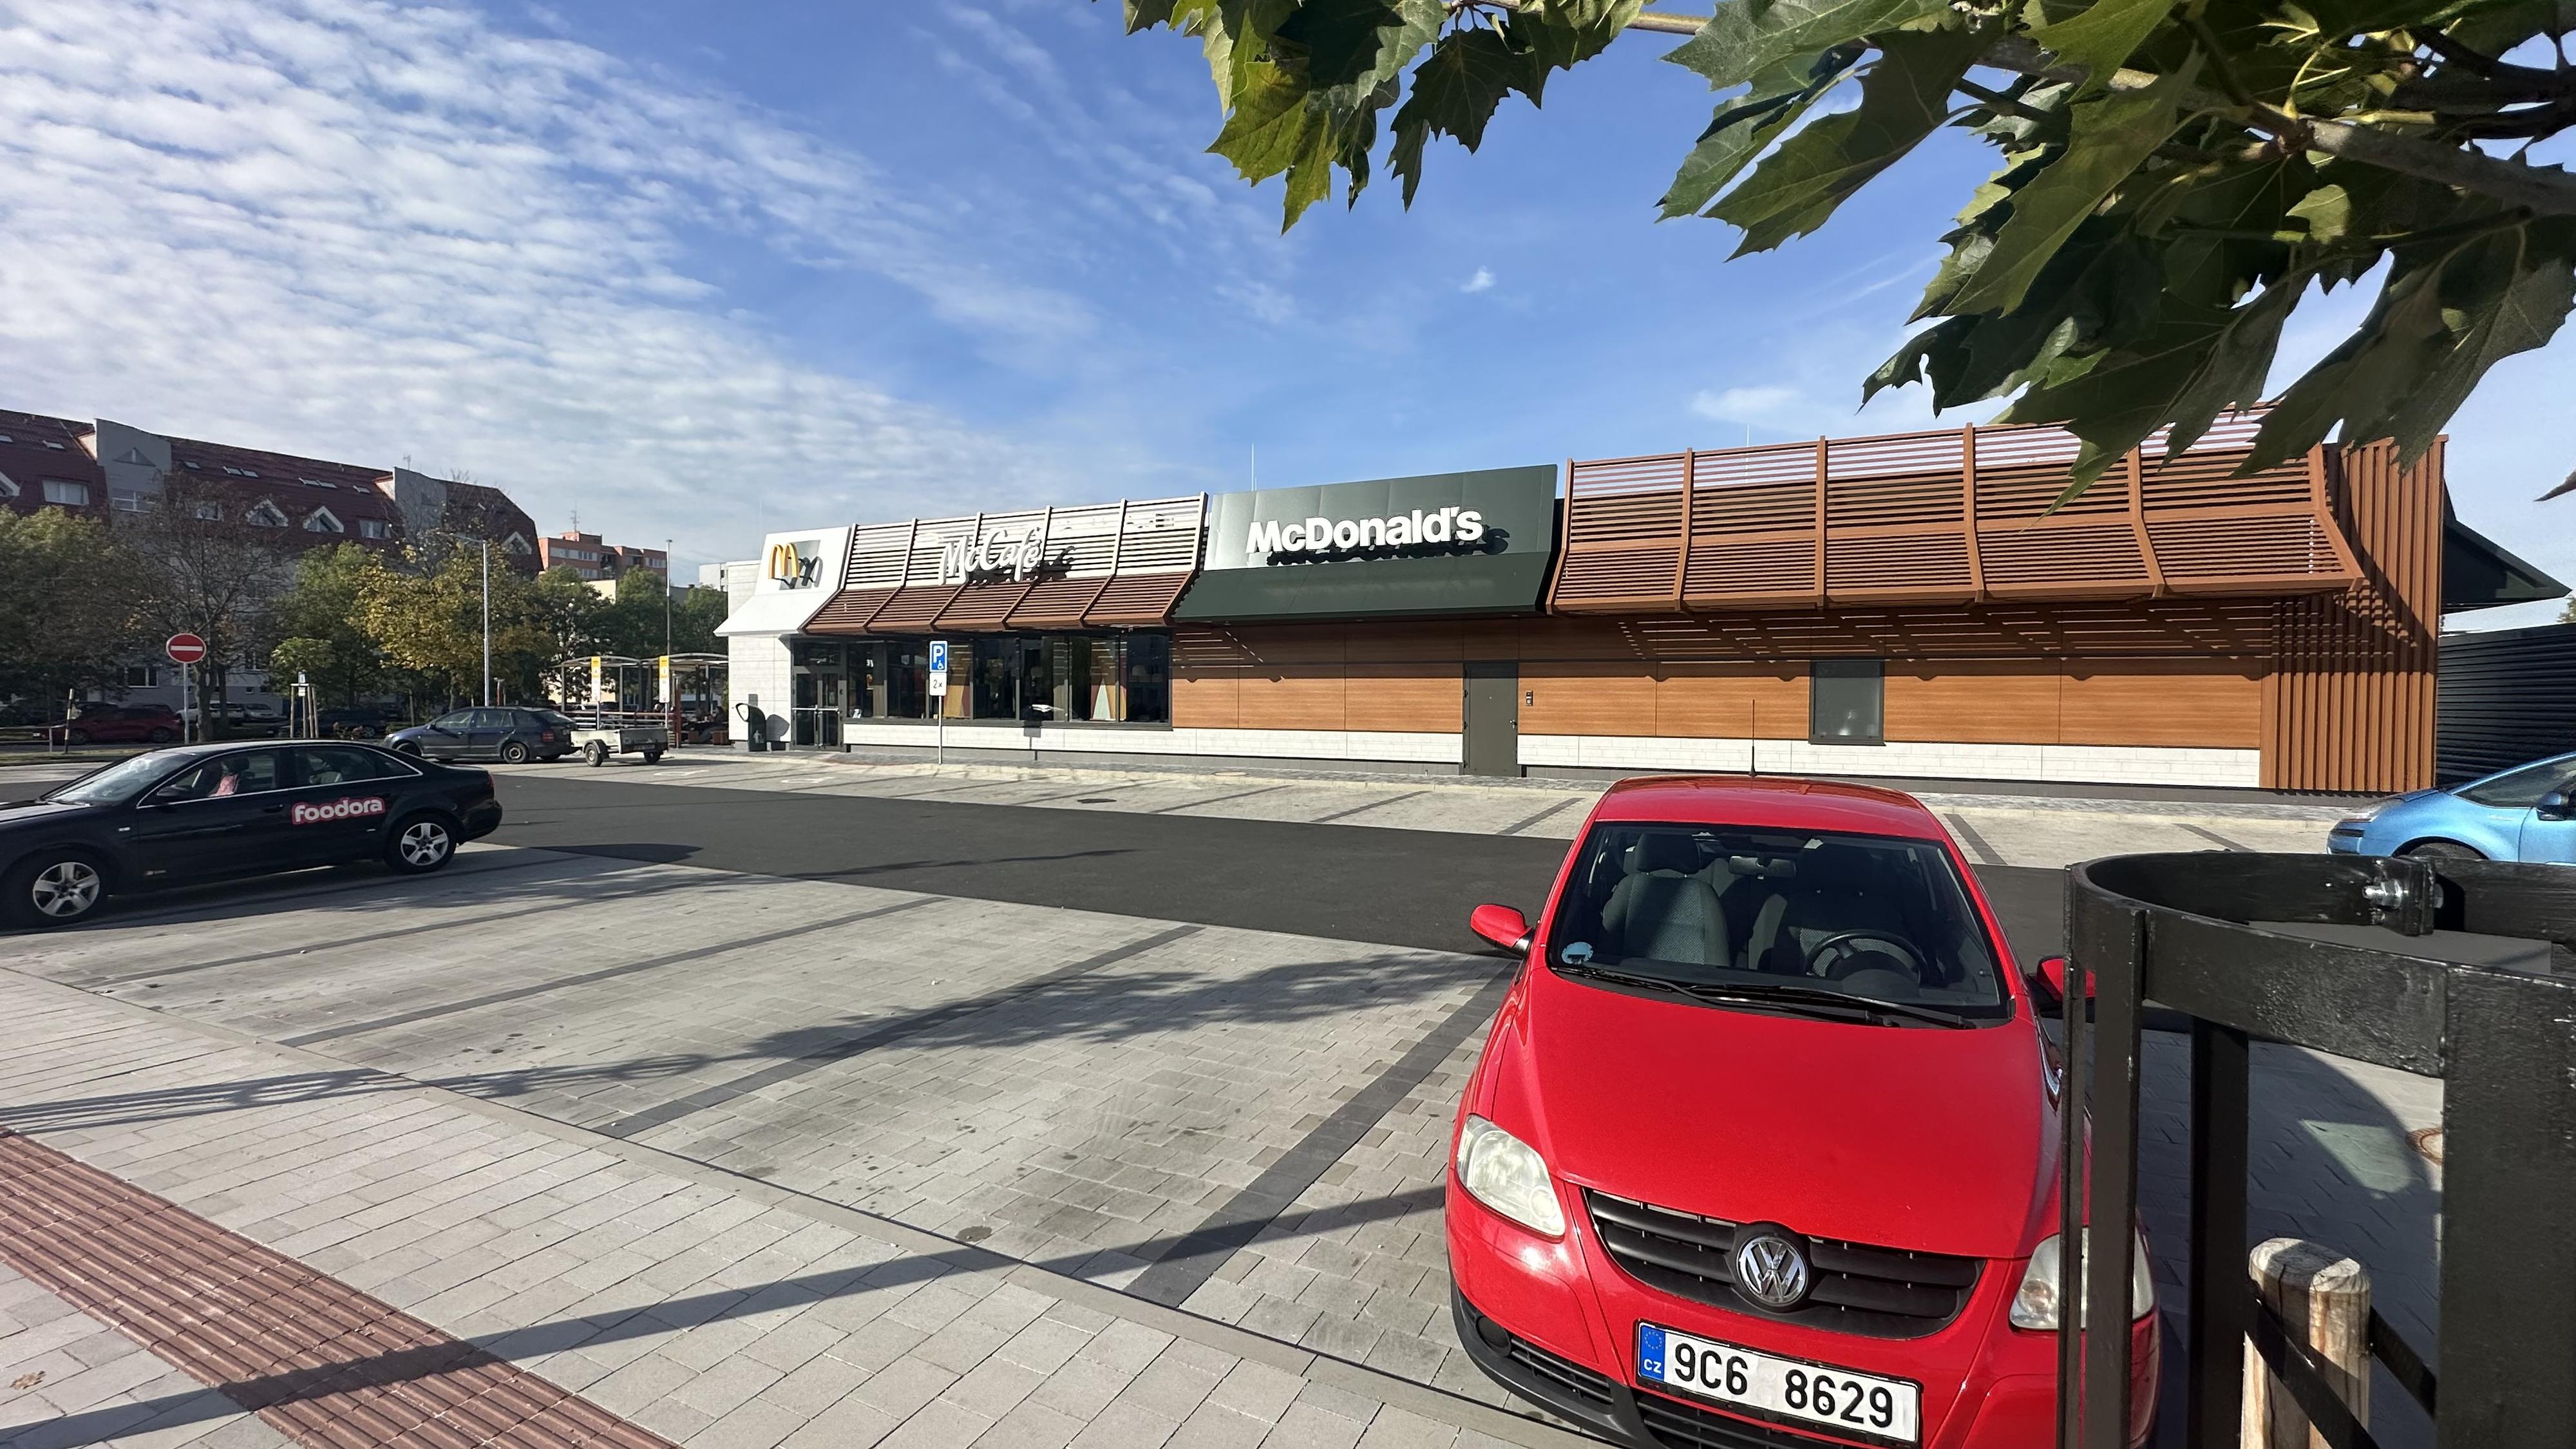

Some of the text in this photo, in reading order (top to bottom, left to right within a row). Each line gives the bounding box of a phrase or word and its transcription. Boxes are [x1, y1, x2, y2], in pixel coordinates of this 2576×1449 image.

[1245, 506, 1483, 553] McDonald's
[938, 526, 1043, 585] McCafé
[933, 645, 944, 663] P
[294, 799, 383, 822] foodora
[1738, 1237, 1807, 1305] VW
[1643, 1358, 1662, 1374] CZ
[1674, 1343, 1893, 1428] 9C6 8629
